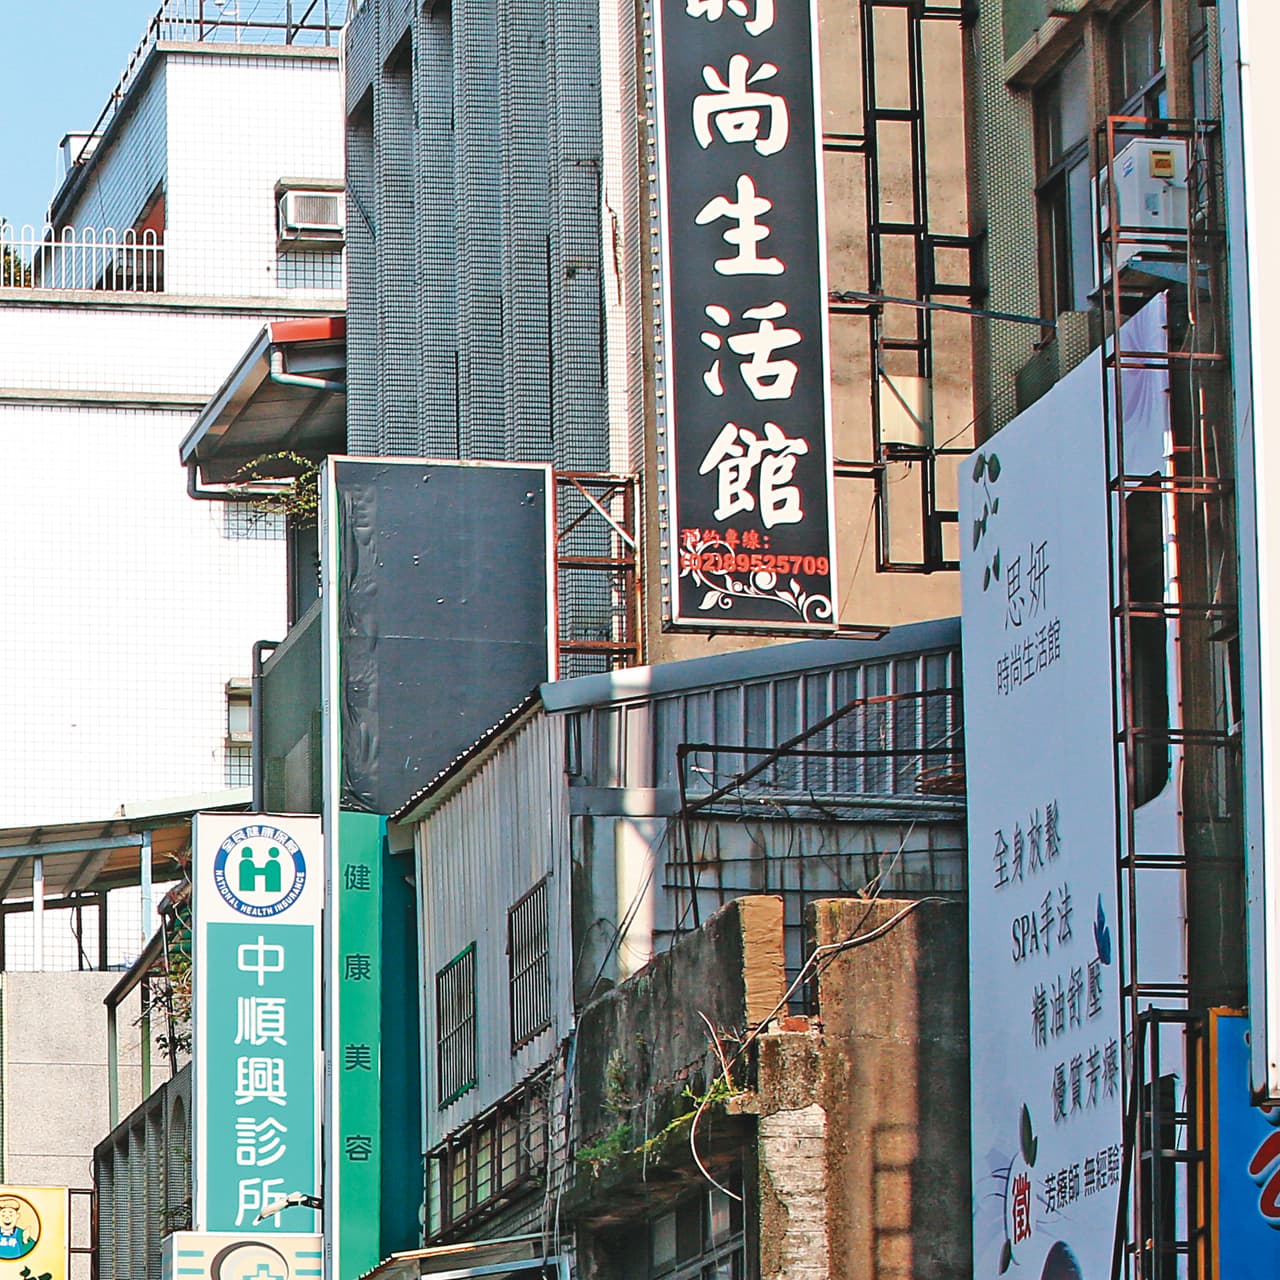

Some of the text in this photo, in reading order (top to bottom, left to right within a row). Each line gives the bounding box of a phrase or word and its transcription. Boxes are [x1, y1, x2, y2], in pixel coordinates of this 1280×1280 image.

[996, 617, 1061, 696] 時尚生活館
[240, 902, 273, 917] HEALTH
[344, 863, 372, 1162] 健康美容
[1032, 960, 1103, 1047] 精油舒壓
[234, 935, 288, 1229] 中順興診所
[1051, 1030, 1135, 1124] 優質芳療
